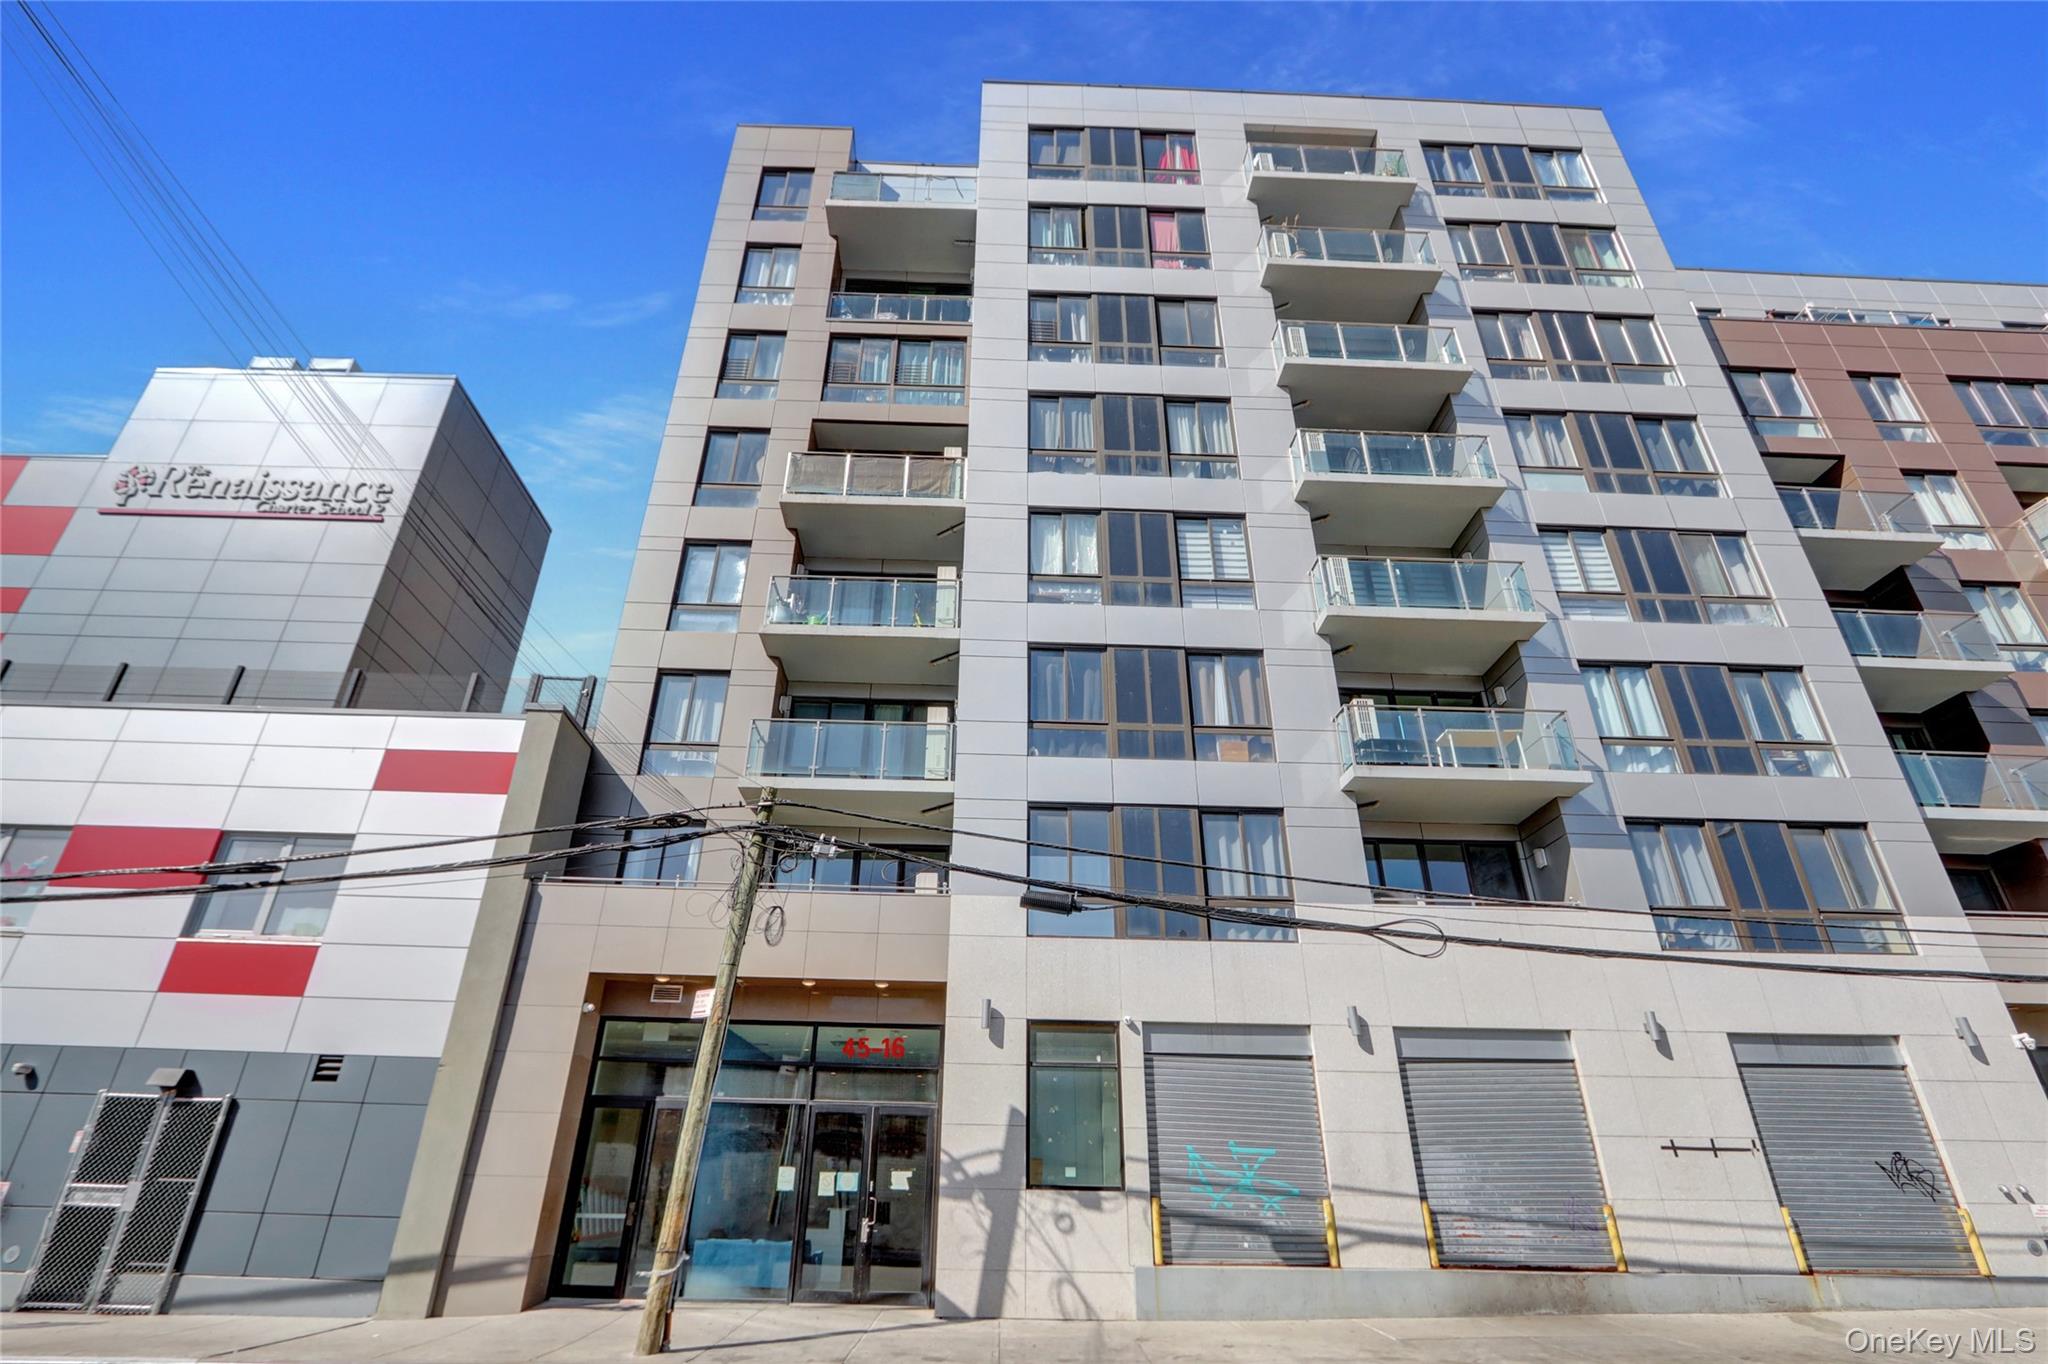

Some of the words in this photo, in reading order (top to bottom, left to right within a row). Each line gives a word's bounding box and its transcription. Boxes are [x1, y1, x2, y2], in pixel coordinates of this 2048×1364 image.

[188, 465, 212, 477] The
[256, 500, 316, 515] Charter
[318, 503, 373, 516] School
[842, 1036, 905, 1059] 45-16
